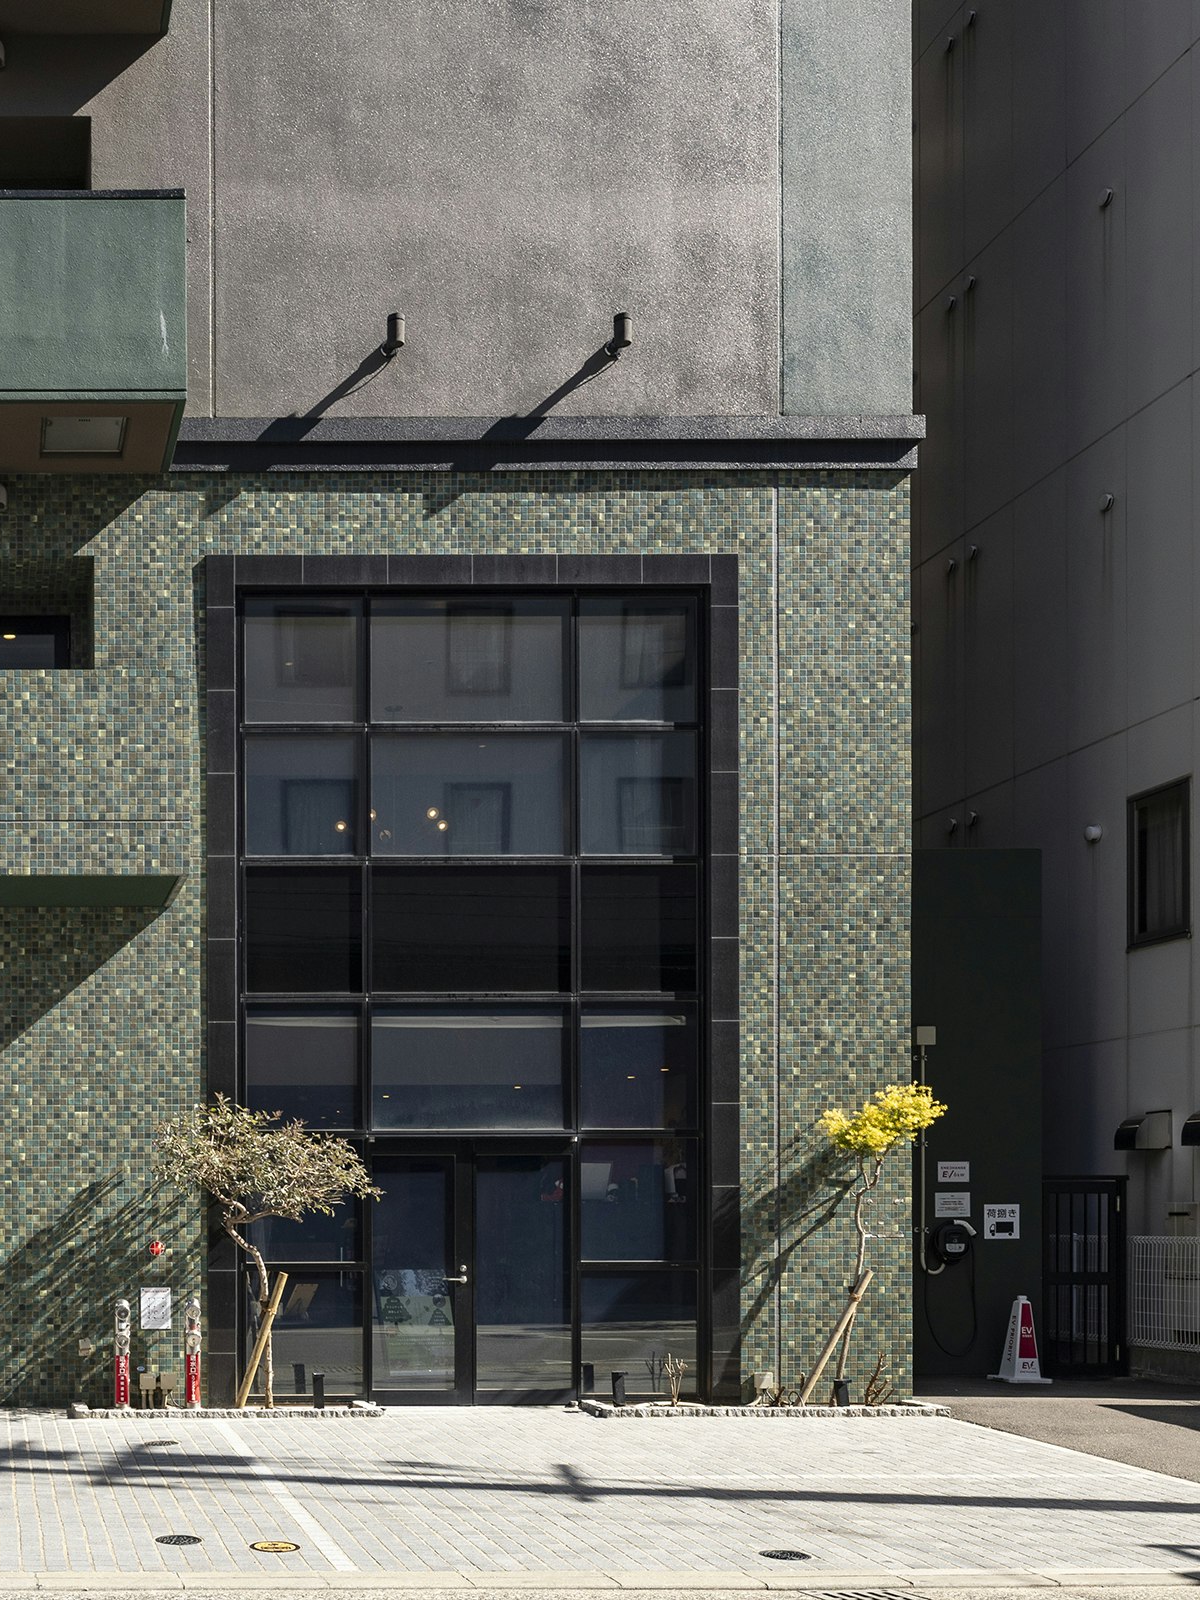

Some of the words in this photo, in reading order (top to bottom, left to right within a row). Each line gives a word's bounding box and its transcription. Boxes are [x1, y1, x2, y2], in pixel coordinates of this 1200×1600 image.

[987, 1208, 1017, 1218] 荷捌き
[1021, 1326, 1033, 1334] EV
[1007, 1328, 1015, 1362] PRIORITY
